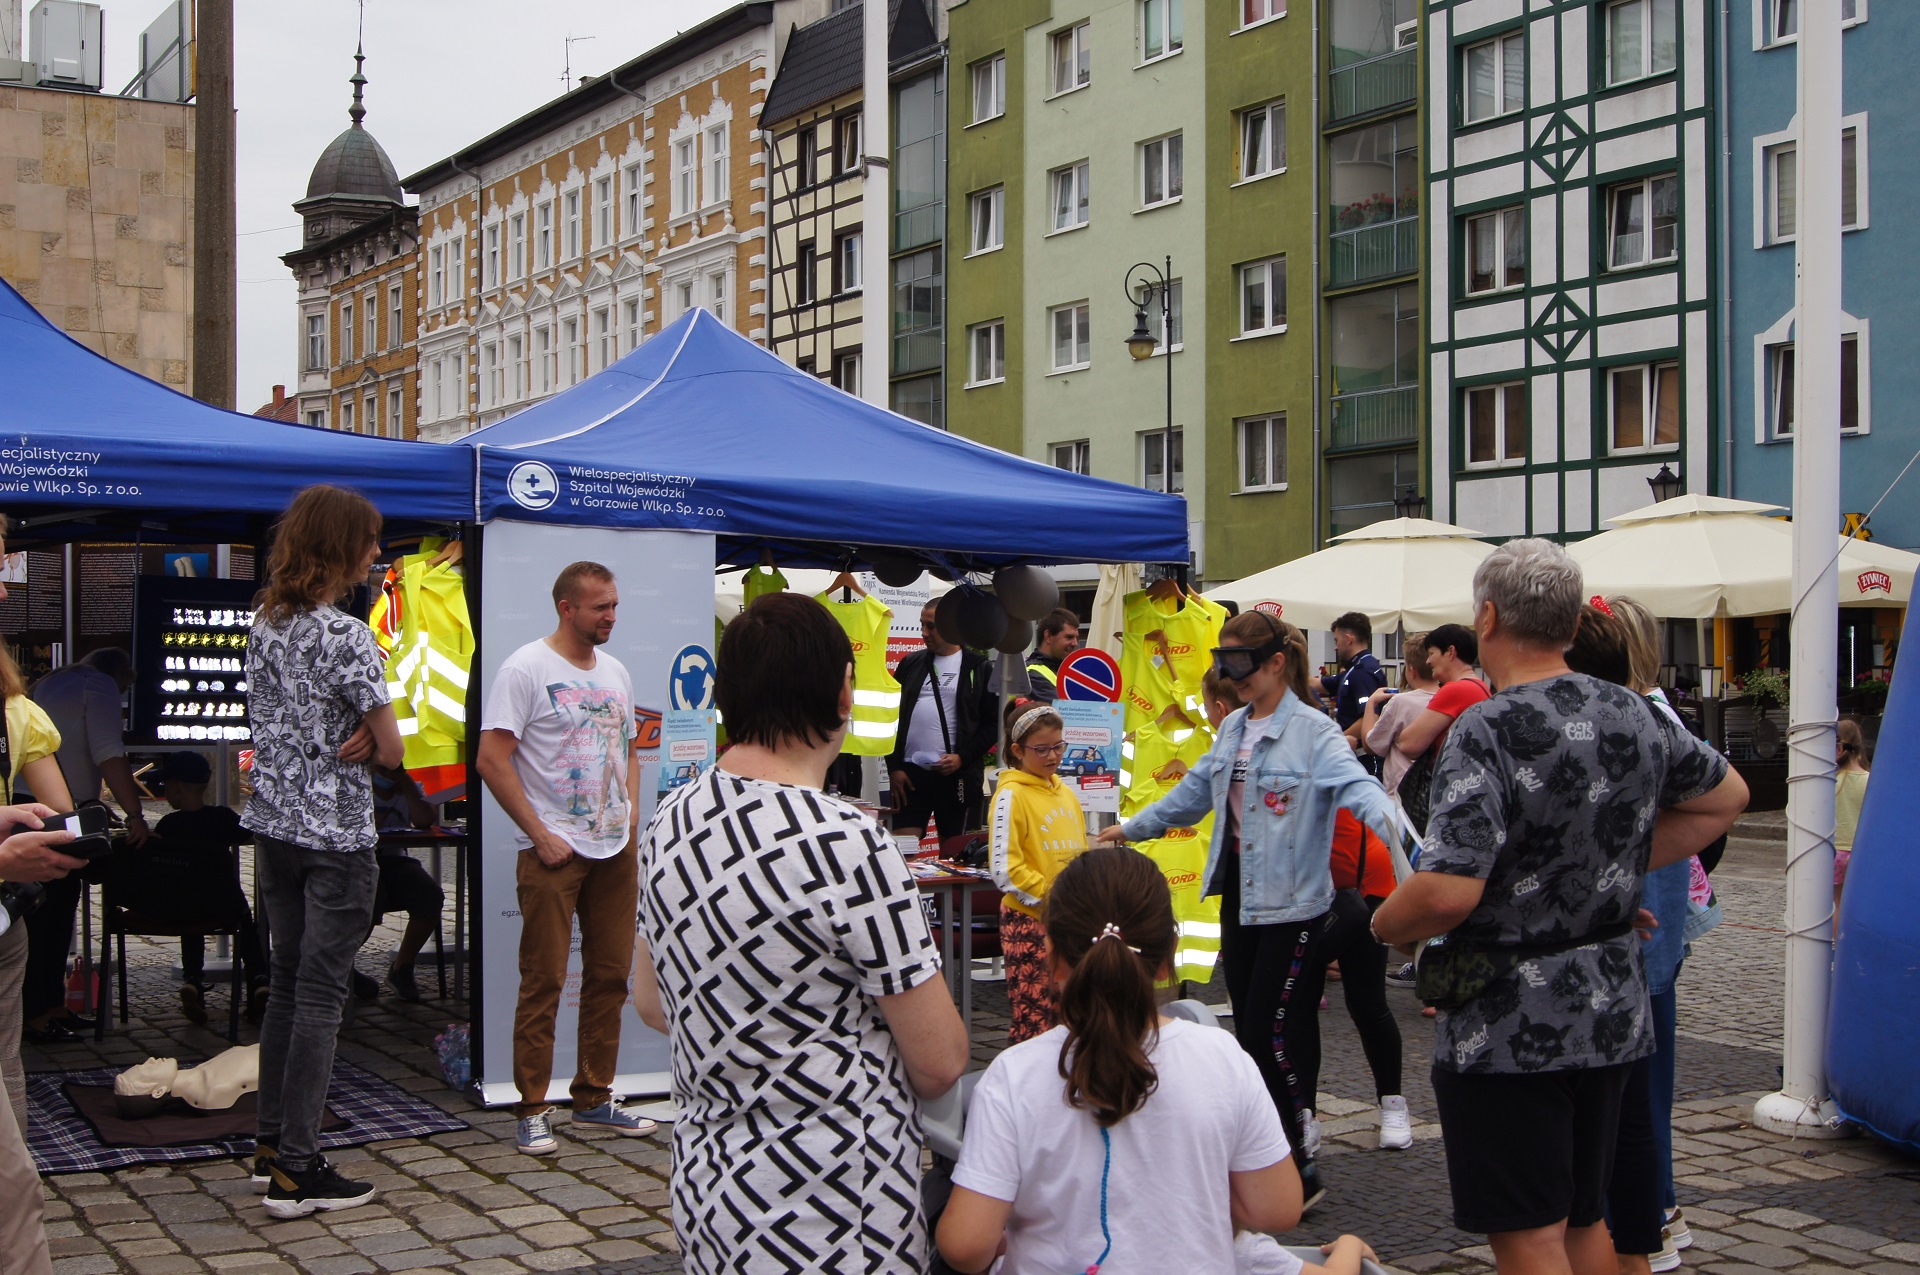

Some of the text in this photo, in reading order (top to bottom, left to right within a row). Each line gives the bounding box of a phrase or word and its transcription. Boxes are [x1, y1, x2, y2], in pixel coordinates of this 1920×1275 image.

[0, 447, 100, 464] ecjalistyczny
[0, 463, 88, 478] Wojewódzki
[569, 465, 696, 487] Wielospecjalistyczny
[33, 480, 74, 496] Wlkp.
[77, 481, 101, 497] Sp.
[105, 485, 113, 495] z
[116, 486, 142, 495] o.o.
[570, 480, 685, 499] Szpital Wojewódzki
[570, 496, 726, 517] w Gorzowie Wlkp. Sp. z o.o.
[1861, 573, 1888, 587] ŻYWIEC
[501, 910, 523, 918] egza
